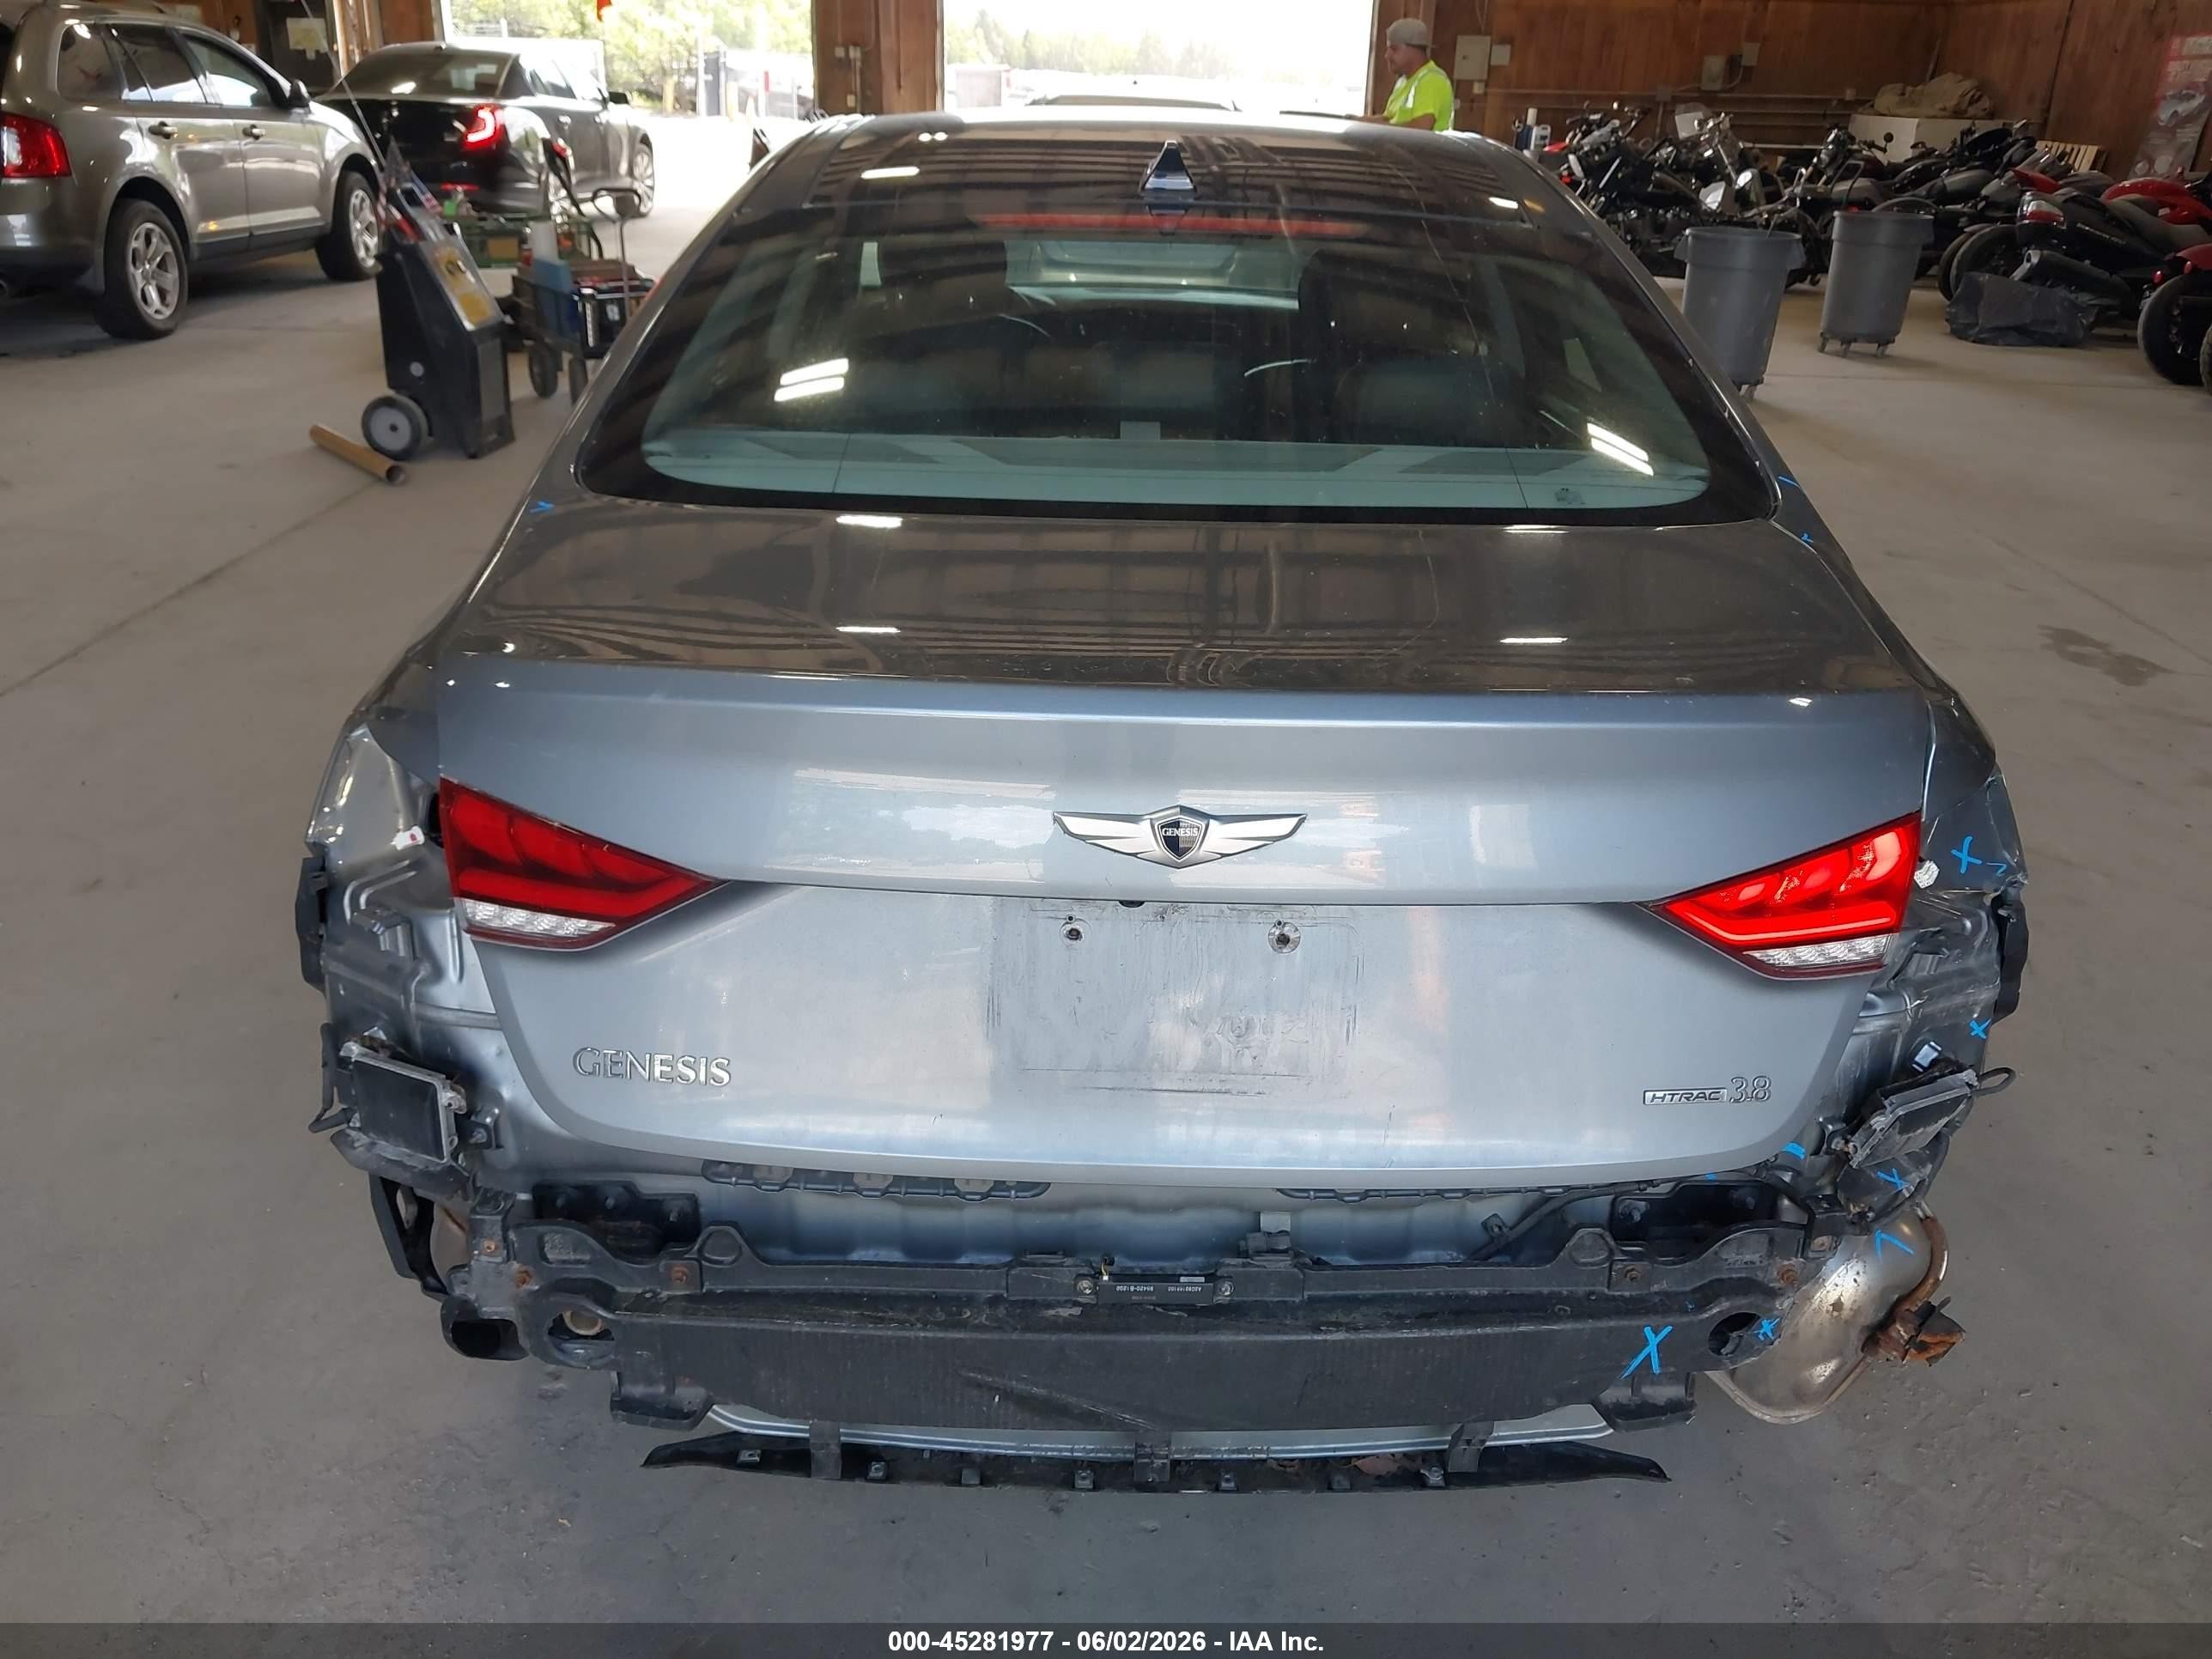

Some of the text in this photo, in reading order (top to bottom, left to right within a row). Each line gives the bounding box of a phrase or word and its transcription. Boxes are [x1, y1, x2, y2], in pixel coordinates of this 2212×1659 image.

[1162, 827, 1199, 837] GENESIS
[573, 1047, 732, 1088] GENESIS
[1650, 1090, 1722, 1104] HTRAC
